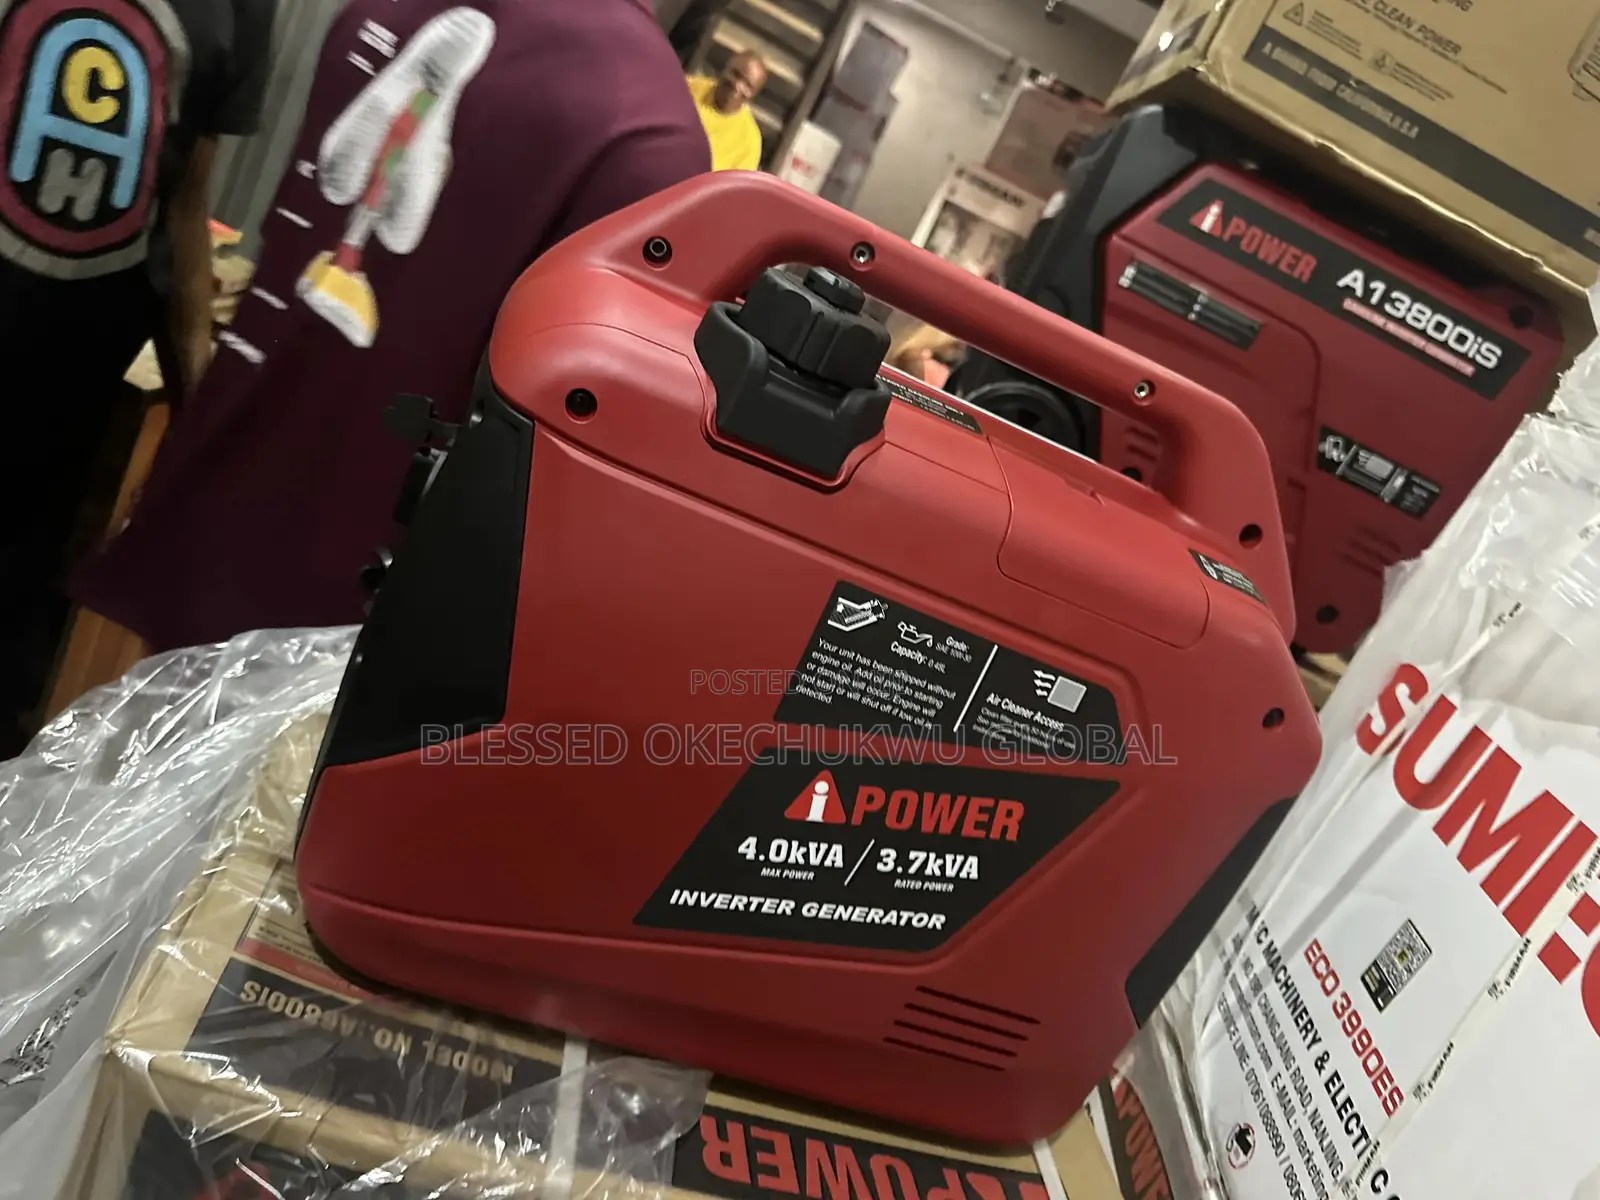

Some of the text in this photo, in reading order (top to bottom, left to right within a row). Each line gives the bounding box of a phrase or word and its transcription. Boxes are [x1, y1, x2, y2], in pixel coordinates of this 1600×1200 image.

[1372, 0, 1414, 29] CLEAN
[1417, 24, 1462, 56] POWER
[818, 637, 957, 700] Your unit has been shipped without
[890, 641, 928, 665] Capacity:
[796, 683, 834, 706] detected.
[801, 672, 816, 685] not
[815, 678, 836, 693] start
[835, 685, 847, 696] or
[847, 689, 862, 702] will
[861, 696, 880, 710] shut
[880, 702, 893, 714] off
[898, 707, 914, 723] low
[806, 661, 818, 672] or
[816, 664, 852, 685] damage
[852, 676, 868, 691] will
[891, 693, 922, 713] Engine
[922, 703, 937, 718] will
[811, 650, 841, 668] engine
[854, 666, 874, 681] Add
[873, 671, 885, 684] oil
[883, 676, 904, 692] prior
[903, 683, 914, 696] to
[913, 689, 945, 711] starting
[985, 692, 1001, 706] Air
[1001, 697, 1035, 719] Cleaner
[1033, 710, 1065, 733] Access
[737, 836, 844, 869] 4.0kVA
[876, 848, 980, 880] 3.7kVA
[760, 866, 815, 882] MAX POWER
[1356, 662, 1600, 1040] SUME
[669, 888, 947, 931] INVERTER GENERATOR
[894, 878, 954, 893] RATED POWER
[1303, 937, 1406, 1118] ECO 3990ES
[422, 1036, 516, 1086] MODEL
[1262, 937, 1390, 1195] MACHINERY & ELECTC
[1270, 1071, 1299, 1130] E-MAIL:
[1289, 1065, 1314, 1115] ROAD,
